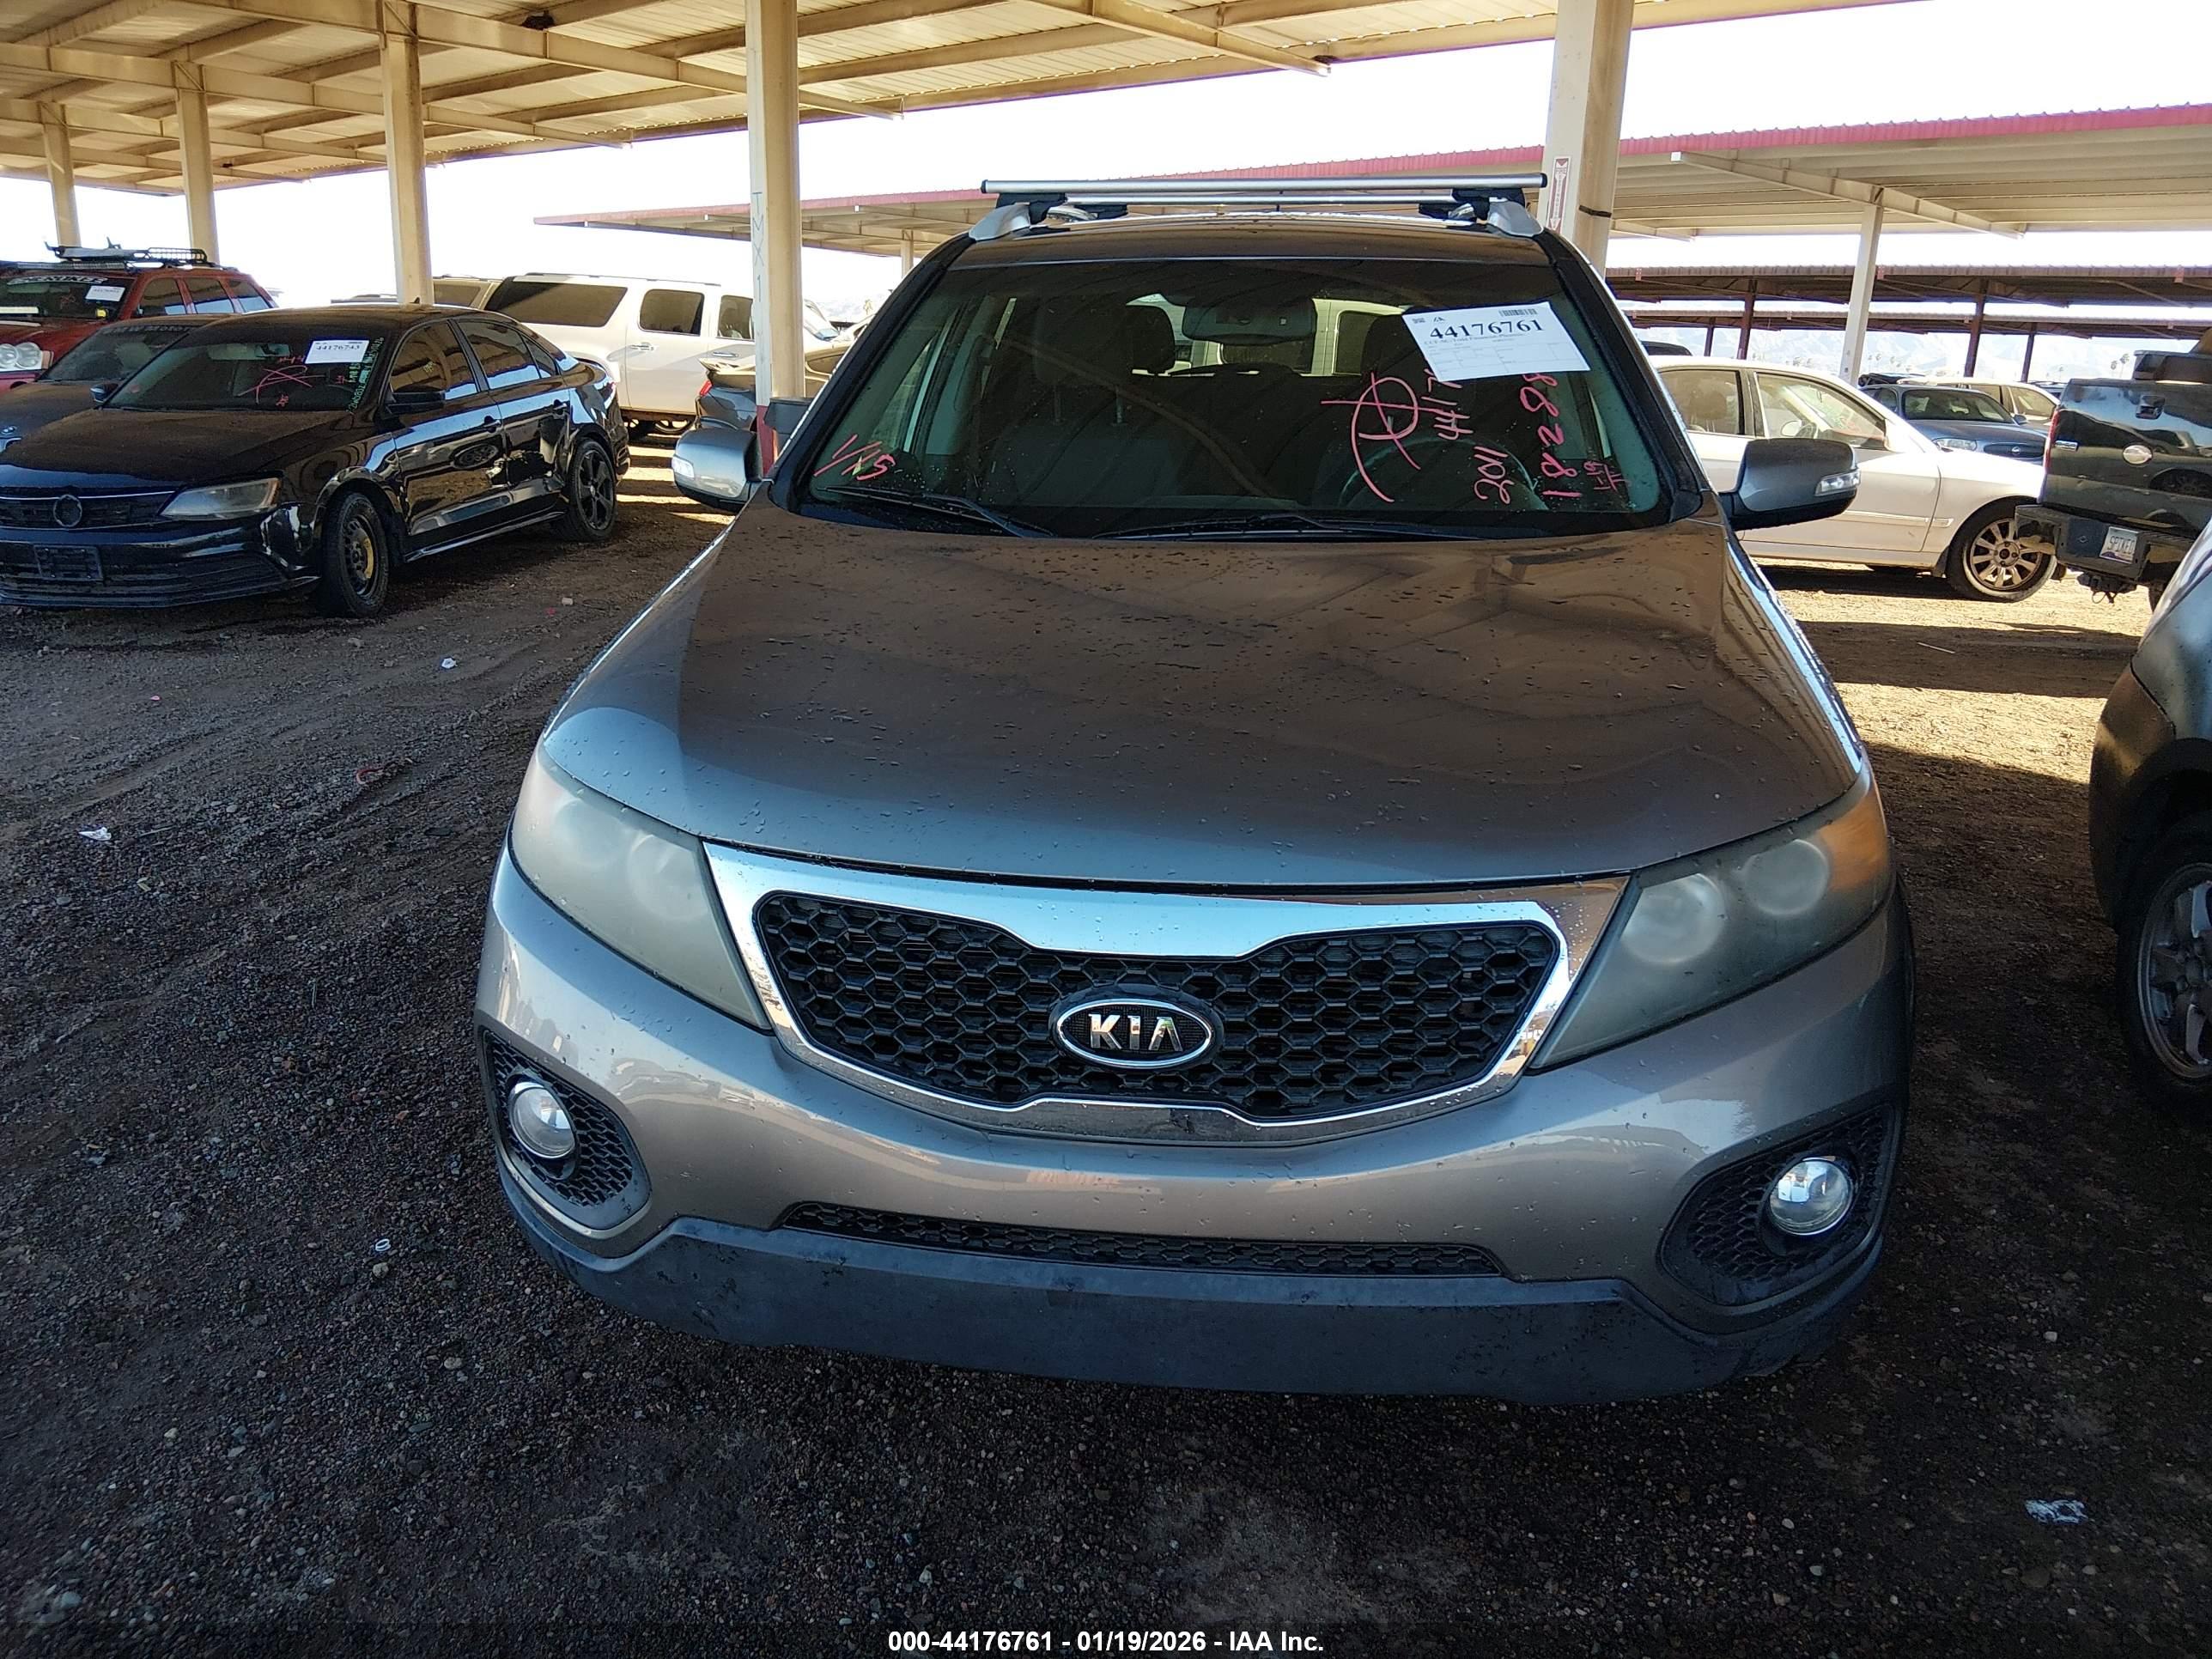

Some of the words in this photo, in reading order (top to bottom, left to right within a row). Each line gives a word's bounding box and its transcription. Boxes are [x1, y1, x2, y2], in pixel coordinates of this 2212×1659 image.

[1430, 319, 1546, 340] 44176761
[1474, 446, 1515, 505] 2011
[1088, 1013, 1183, 1052] KIA
